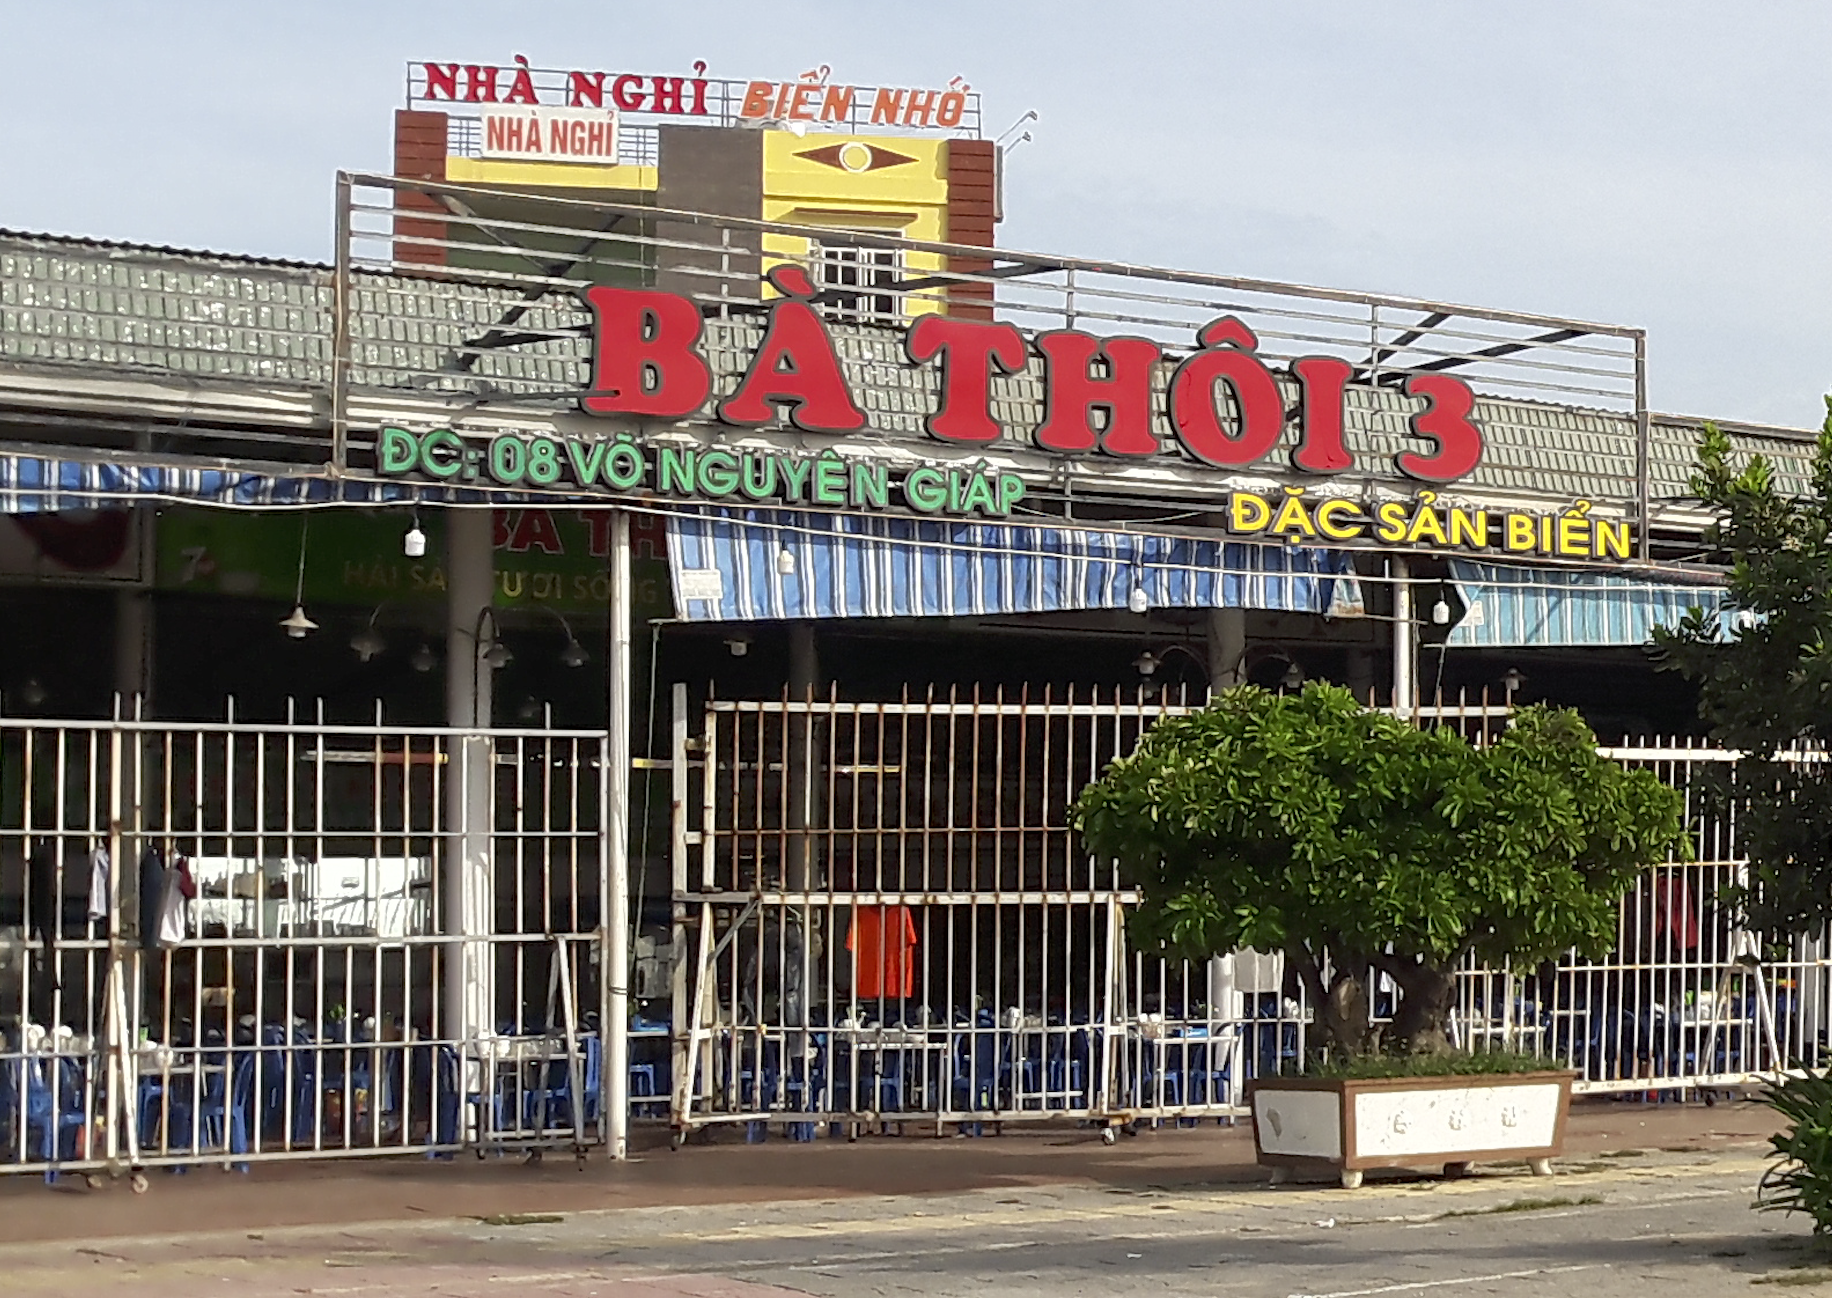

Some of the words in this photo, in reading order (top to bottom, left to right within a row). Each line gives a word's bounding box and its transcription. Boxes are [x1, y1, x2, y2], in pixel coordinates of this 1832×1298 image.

[422, 54, 539, 105] NHÀ
[569, 60, 708, 115] NGHỈ
[740, 65, 855, 122] BIỂN
[870, 76, 971, 127] NHỚ
[486, 111, 542, 153] NHÀ
[550, 110, 614, 157] NGHỈ
[583, 265, 866, 432] BÀ
[906, 314, 1354, 475] THÔI
[1396, 370, 1482, 482] 3
[380, 427, 477, 480] ĐC:
[492, 436, 561, 485] 08
[568, 433, 646, 491] VÕ
[661, 446, 888, 507] NGUYÊN
[904, 462, 1027, 515] GIÁP
[1229, 486, 1362, 544] ĐẶC
[1377, 490, 1488, 548] SẢN
[1507, 498, 1631, 560] BIỂN
